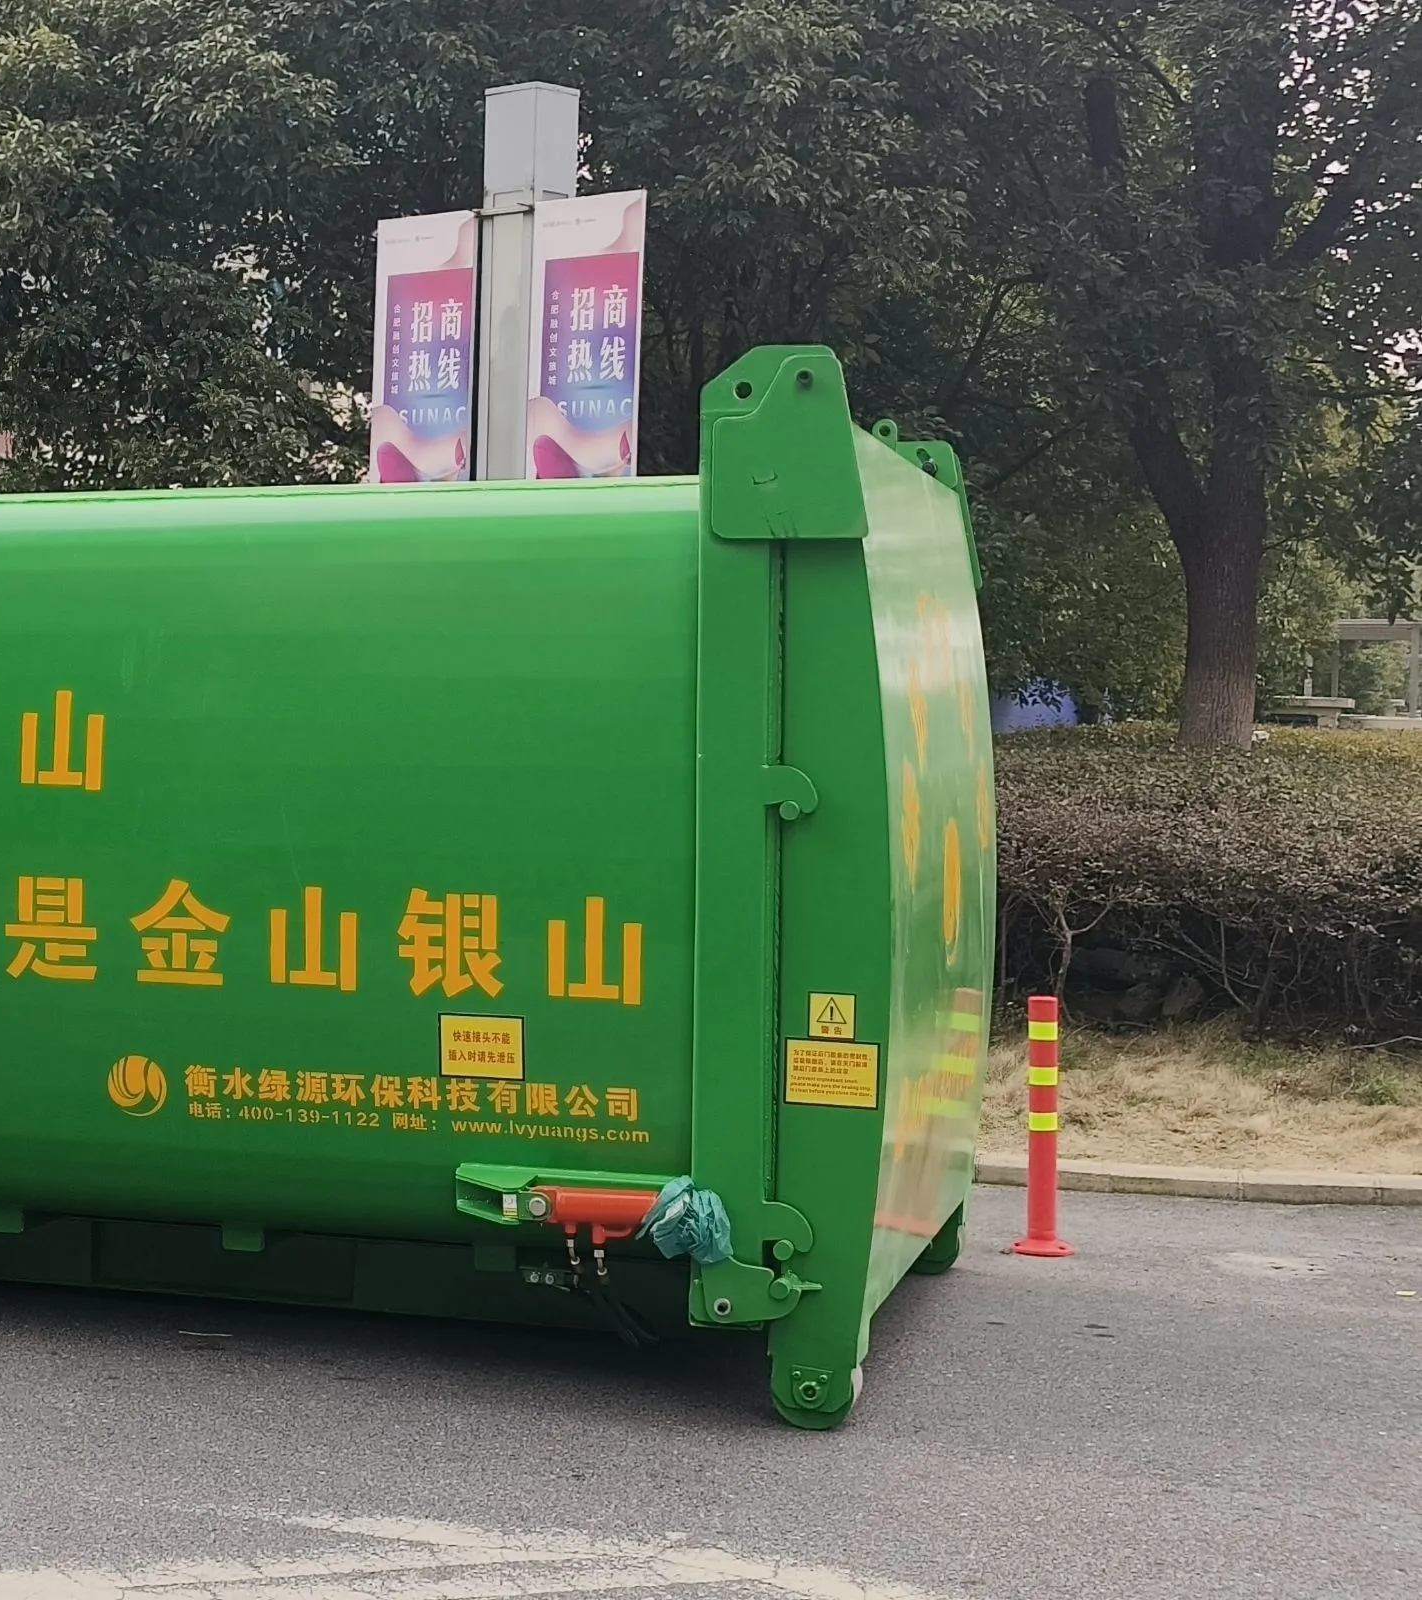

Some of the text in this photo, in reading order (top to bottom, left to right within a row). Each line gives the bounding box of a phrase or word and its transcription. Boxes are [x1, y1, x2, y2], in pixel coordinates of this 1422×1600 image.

[411, 298, 464, 343] 招商
[570, 284, 628, 331] 招商
[408, 347, 461, 392] 热线
[567, 336, 626, 383] 热线
[399, 406, 466, 426] SUNAC
[558, 398, 632, 419] SUNAC
[448, 1049, 516, 1064] 插入时请先泄压
[453, 1030, 511, 1045] 快速接头不能
[183, 1064, 638, 1122] 衡水绿源环保科技有限公司
[238, 1105, 380, 1127] 400-139-1122
[451, 1119, 650, 1142] www.lvyuangs.com
